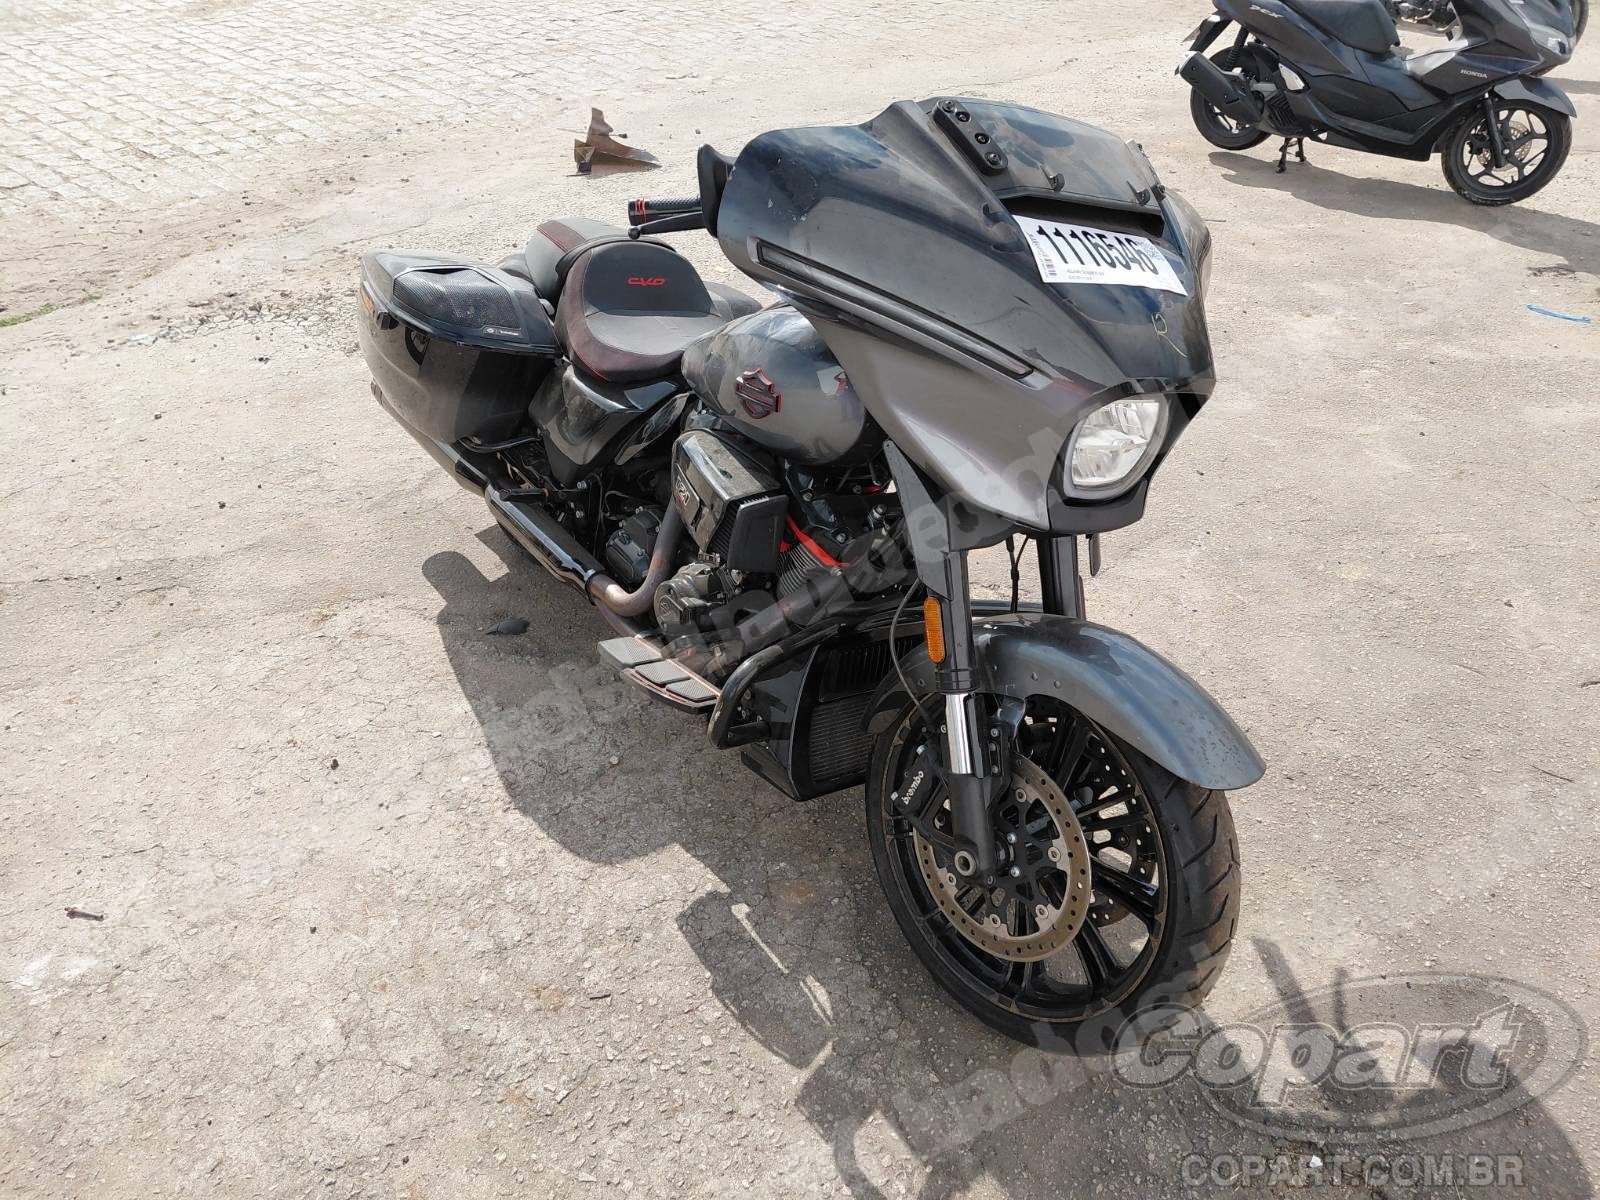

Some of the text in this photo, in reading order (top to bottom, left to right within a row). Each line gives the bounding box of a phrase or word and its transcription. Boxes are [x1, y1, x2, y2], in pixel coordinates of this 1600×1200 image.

[1460, 69, 1488, 79] HONDA
[1036, 224, 1159, 276] 1116546
[627, 276, 666, 287] CVO
[901, 770, 924, 805] brembo
